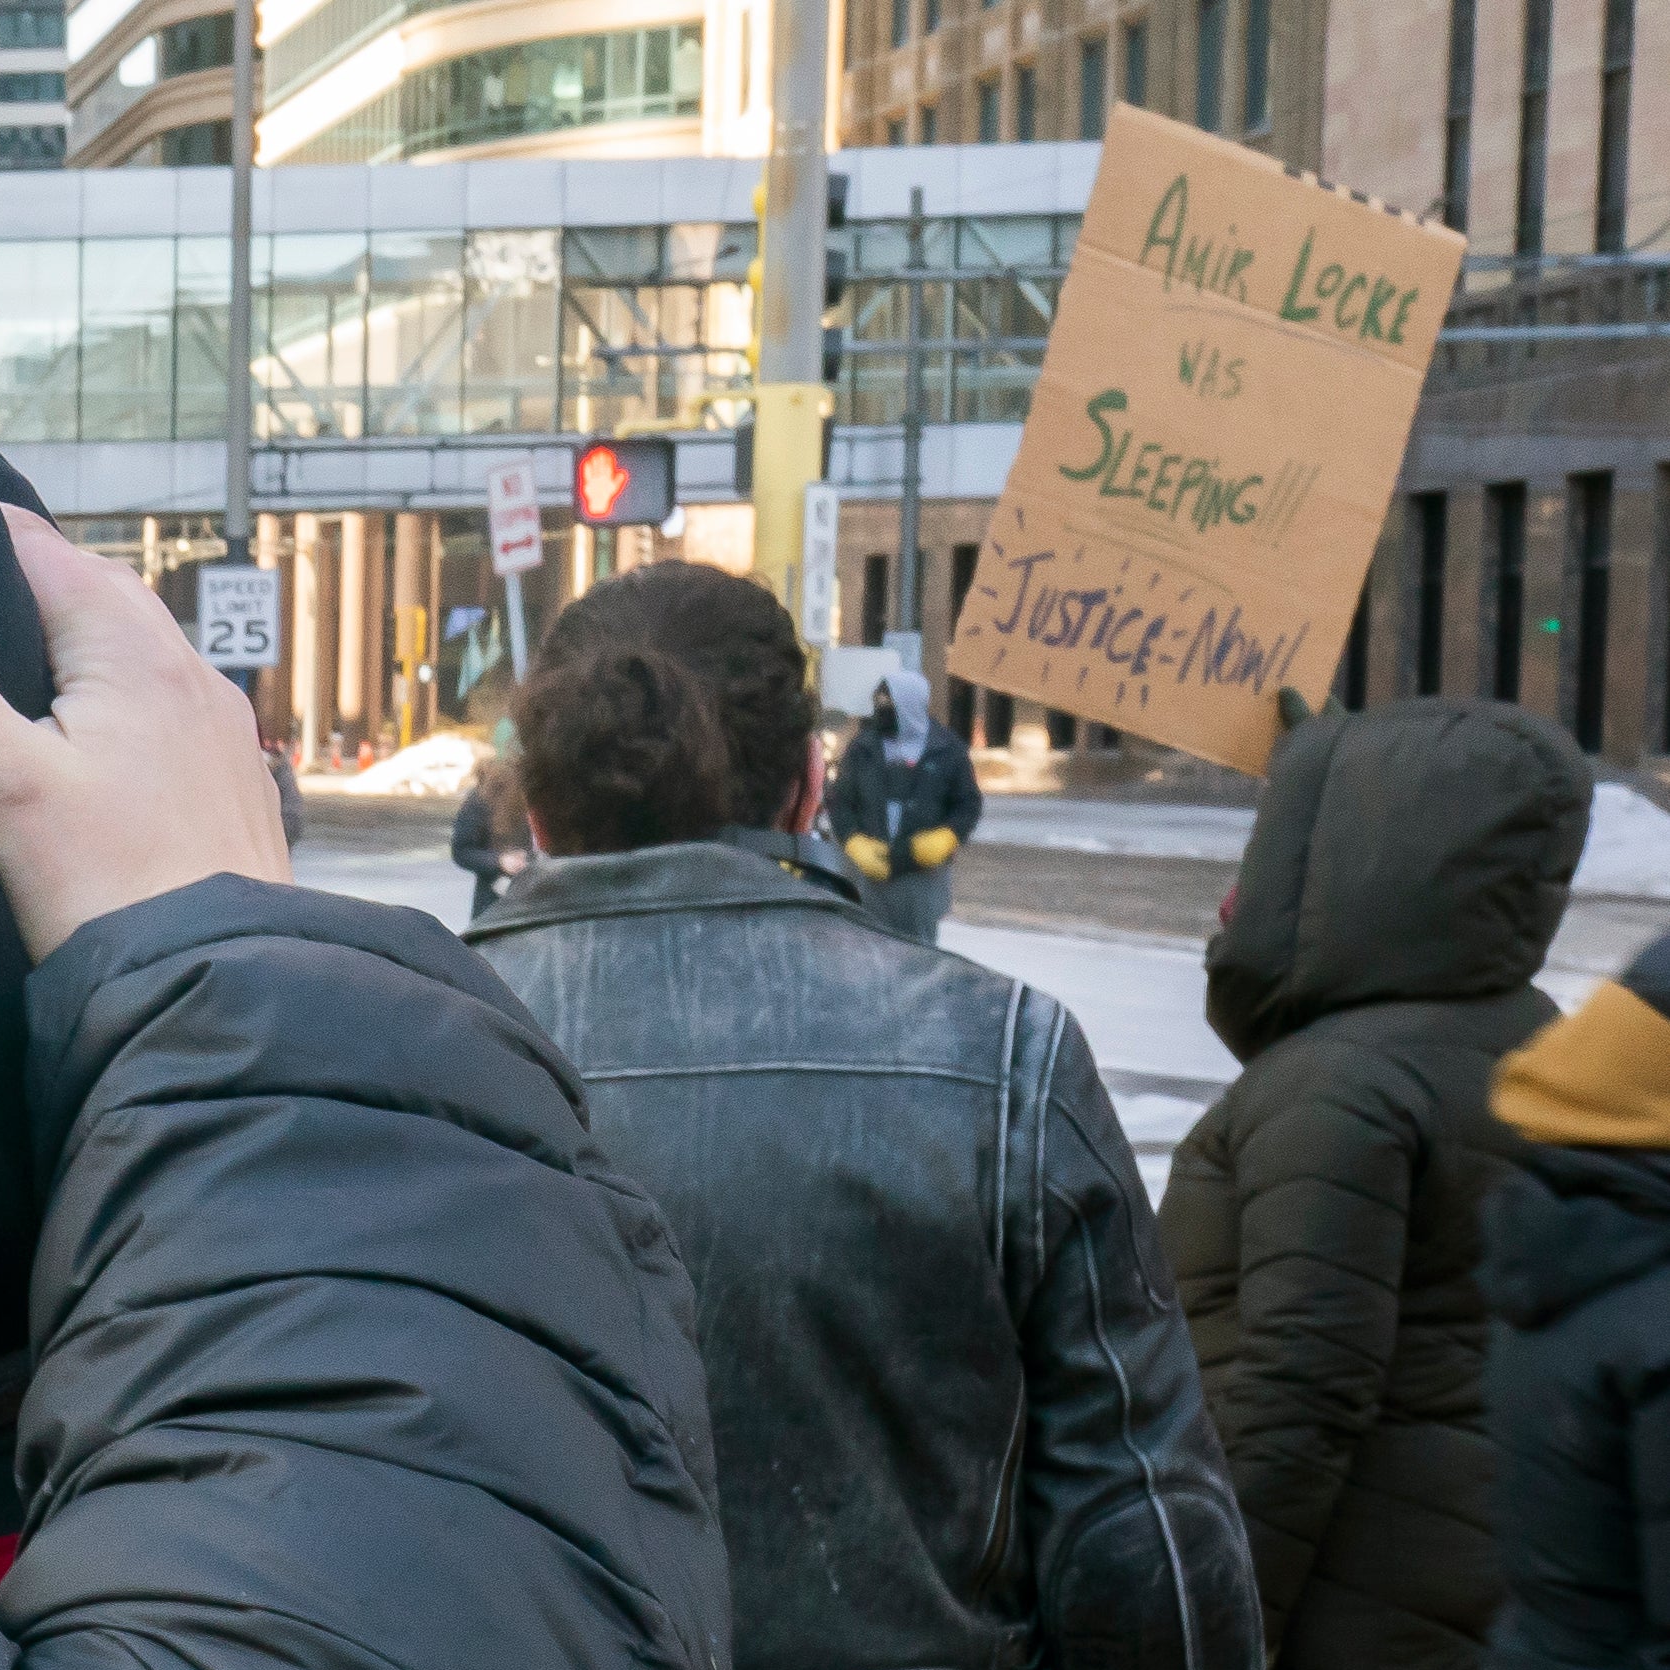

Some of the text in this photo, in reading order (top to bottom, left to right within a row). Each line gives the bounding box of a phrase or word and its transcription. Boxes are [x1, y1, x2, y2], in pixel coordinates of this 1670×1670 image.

[1278, 226, 1420, 345] LOCKE
[1178, 341, 1244, 399] WAS
[208, 619, 270, 655] 25
